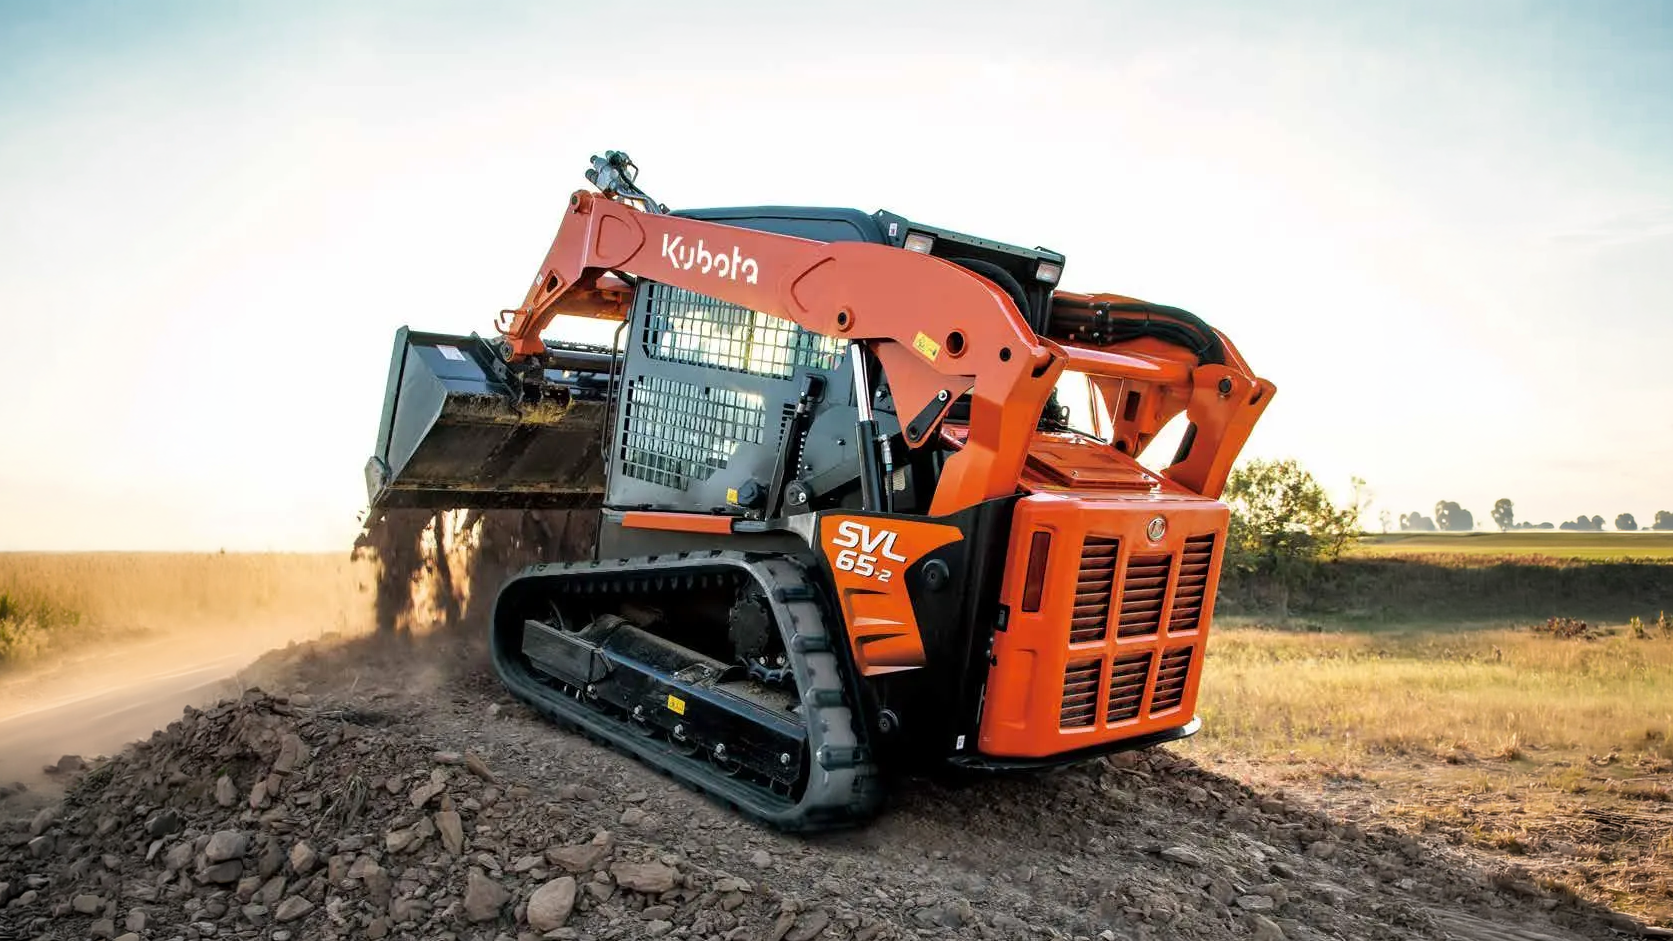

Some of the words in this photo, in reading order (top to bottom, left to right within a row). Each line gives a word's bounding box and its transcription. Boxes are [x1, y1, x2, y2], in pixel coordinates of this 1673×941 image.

[661, 233, 758, 284] Kubota
[832, 520, 907, 562] SVL
[835, 550, 892, 582] 65-2
